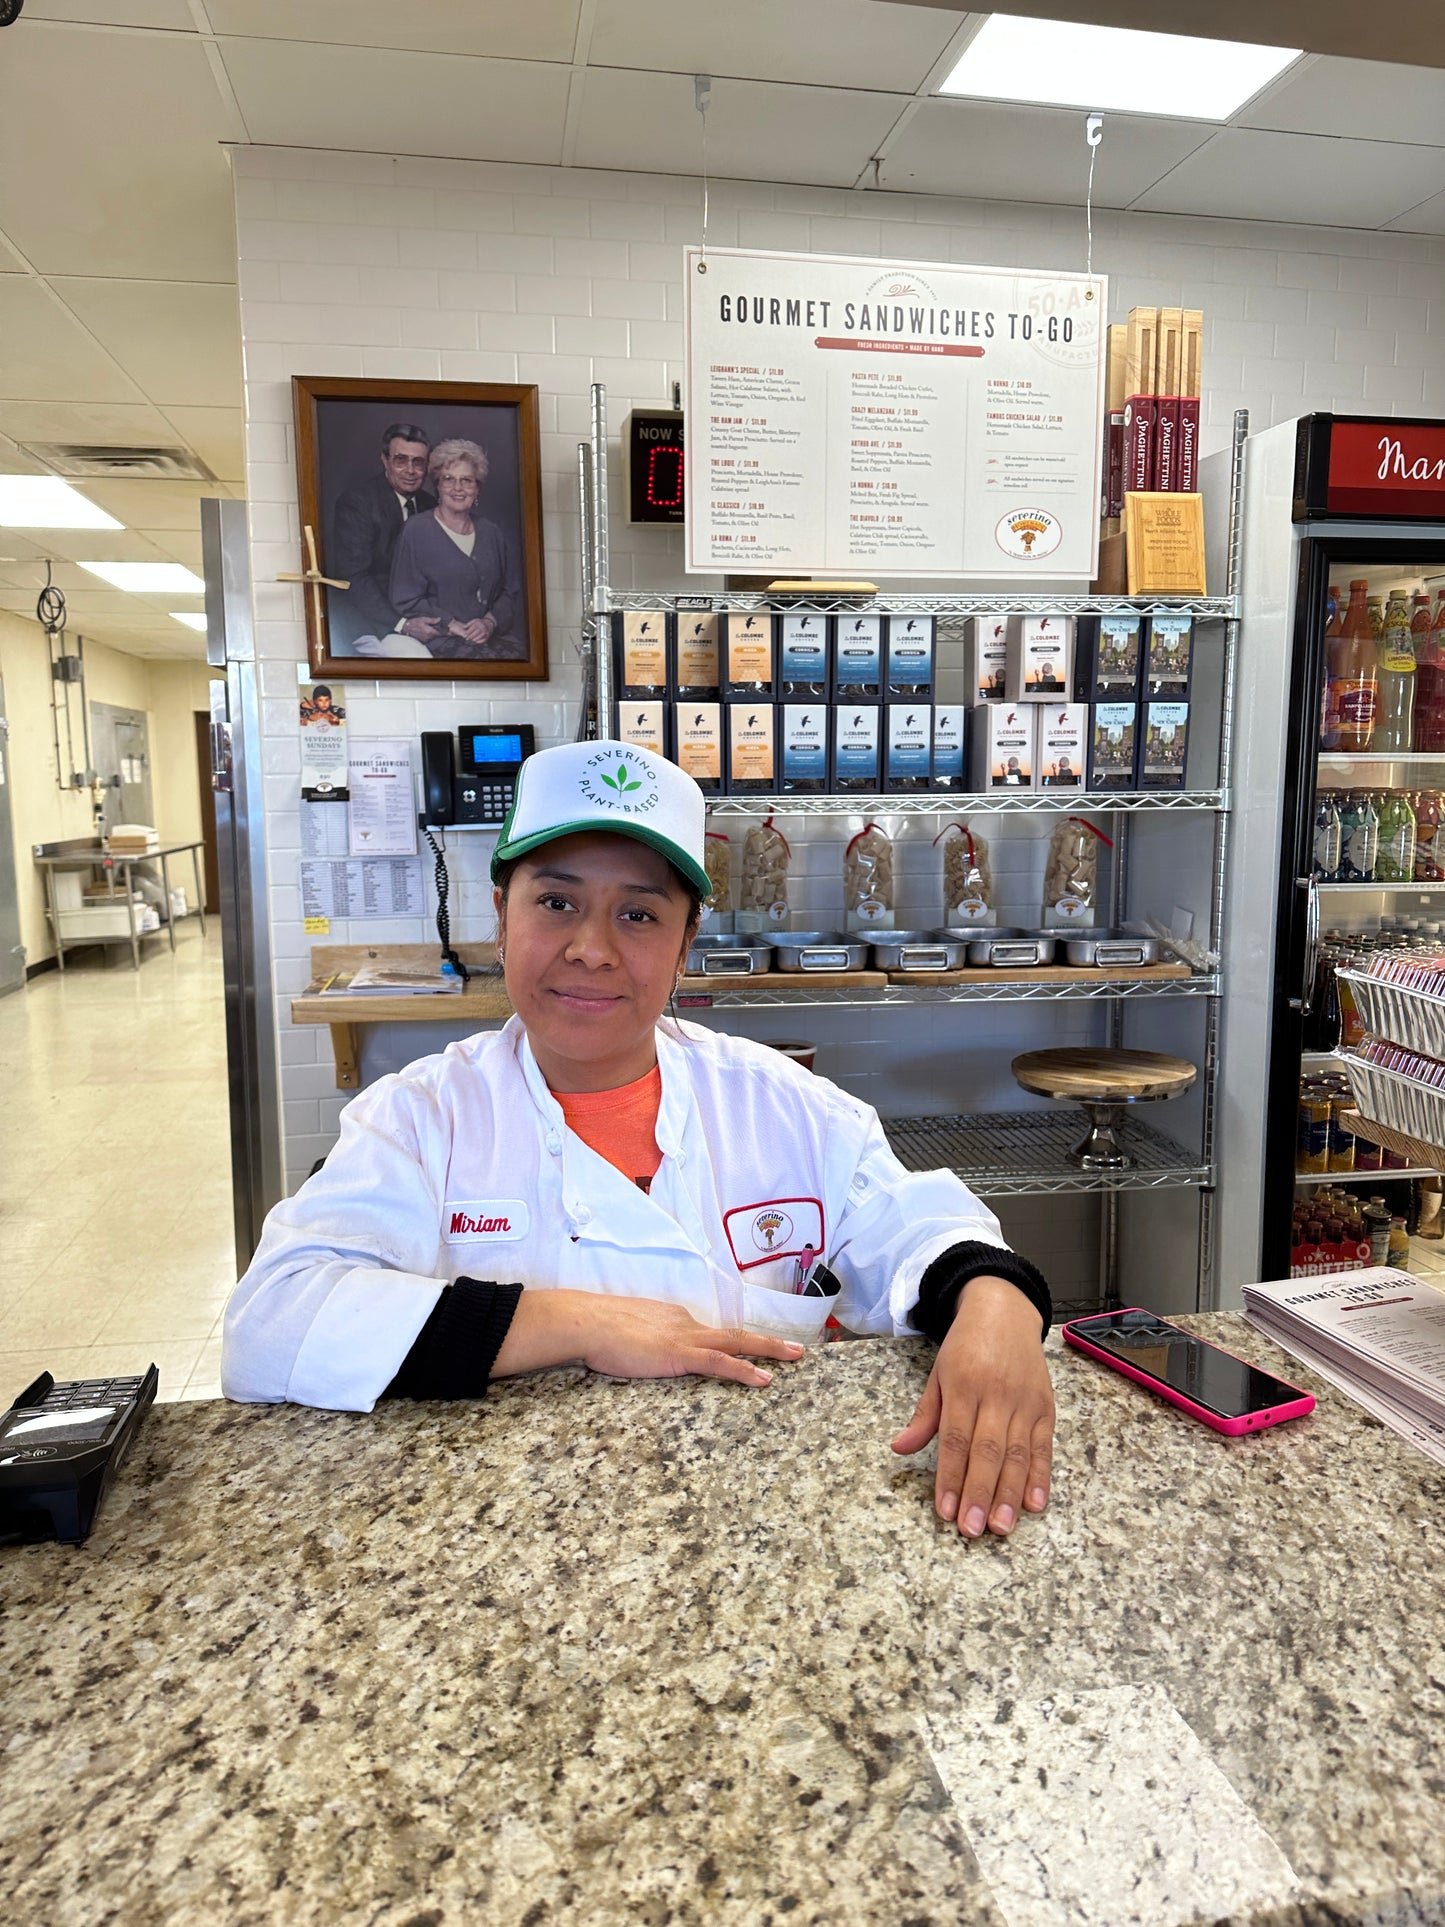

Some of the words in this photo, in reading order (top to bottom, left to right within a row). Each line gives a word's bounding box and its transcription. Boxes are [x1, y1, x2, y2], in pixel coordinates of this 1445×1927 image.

[720, 294, 831, 328] GOURMET
[845, 303, 995, 338] SANDWICHES
[1008, 313, 1073, 343] TO-GO
[857, 341, 872, 349] FRESH
[639, 427, 673, 440] NOW
[1136, 415, 1149, 489] SPAGHETTINI
[1161, 417, 1174, 491] SPAGHETTINI
[1182, 417, 1195, 491] SPAGHETTINI
[1007, 510, 1051, 526] severino
[587, 750, 656, 780] SEVERINO
[578, 780, 659, 813] PLANT-BASED
[450, 1212, 511, 1234] Miriam
[1285, 1291, 1335, 1305] GOURMET
[1341, 1279, 1417, 1295] SANDWICHES
[1344, 1292, 1384, 1303] TO-GO
